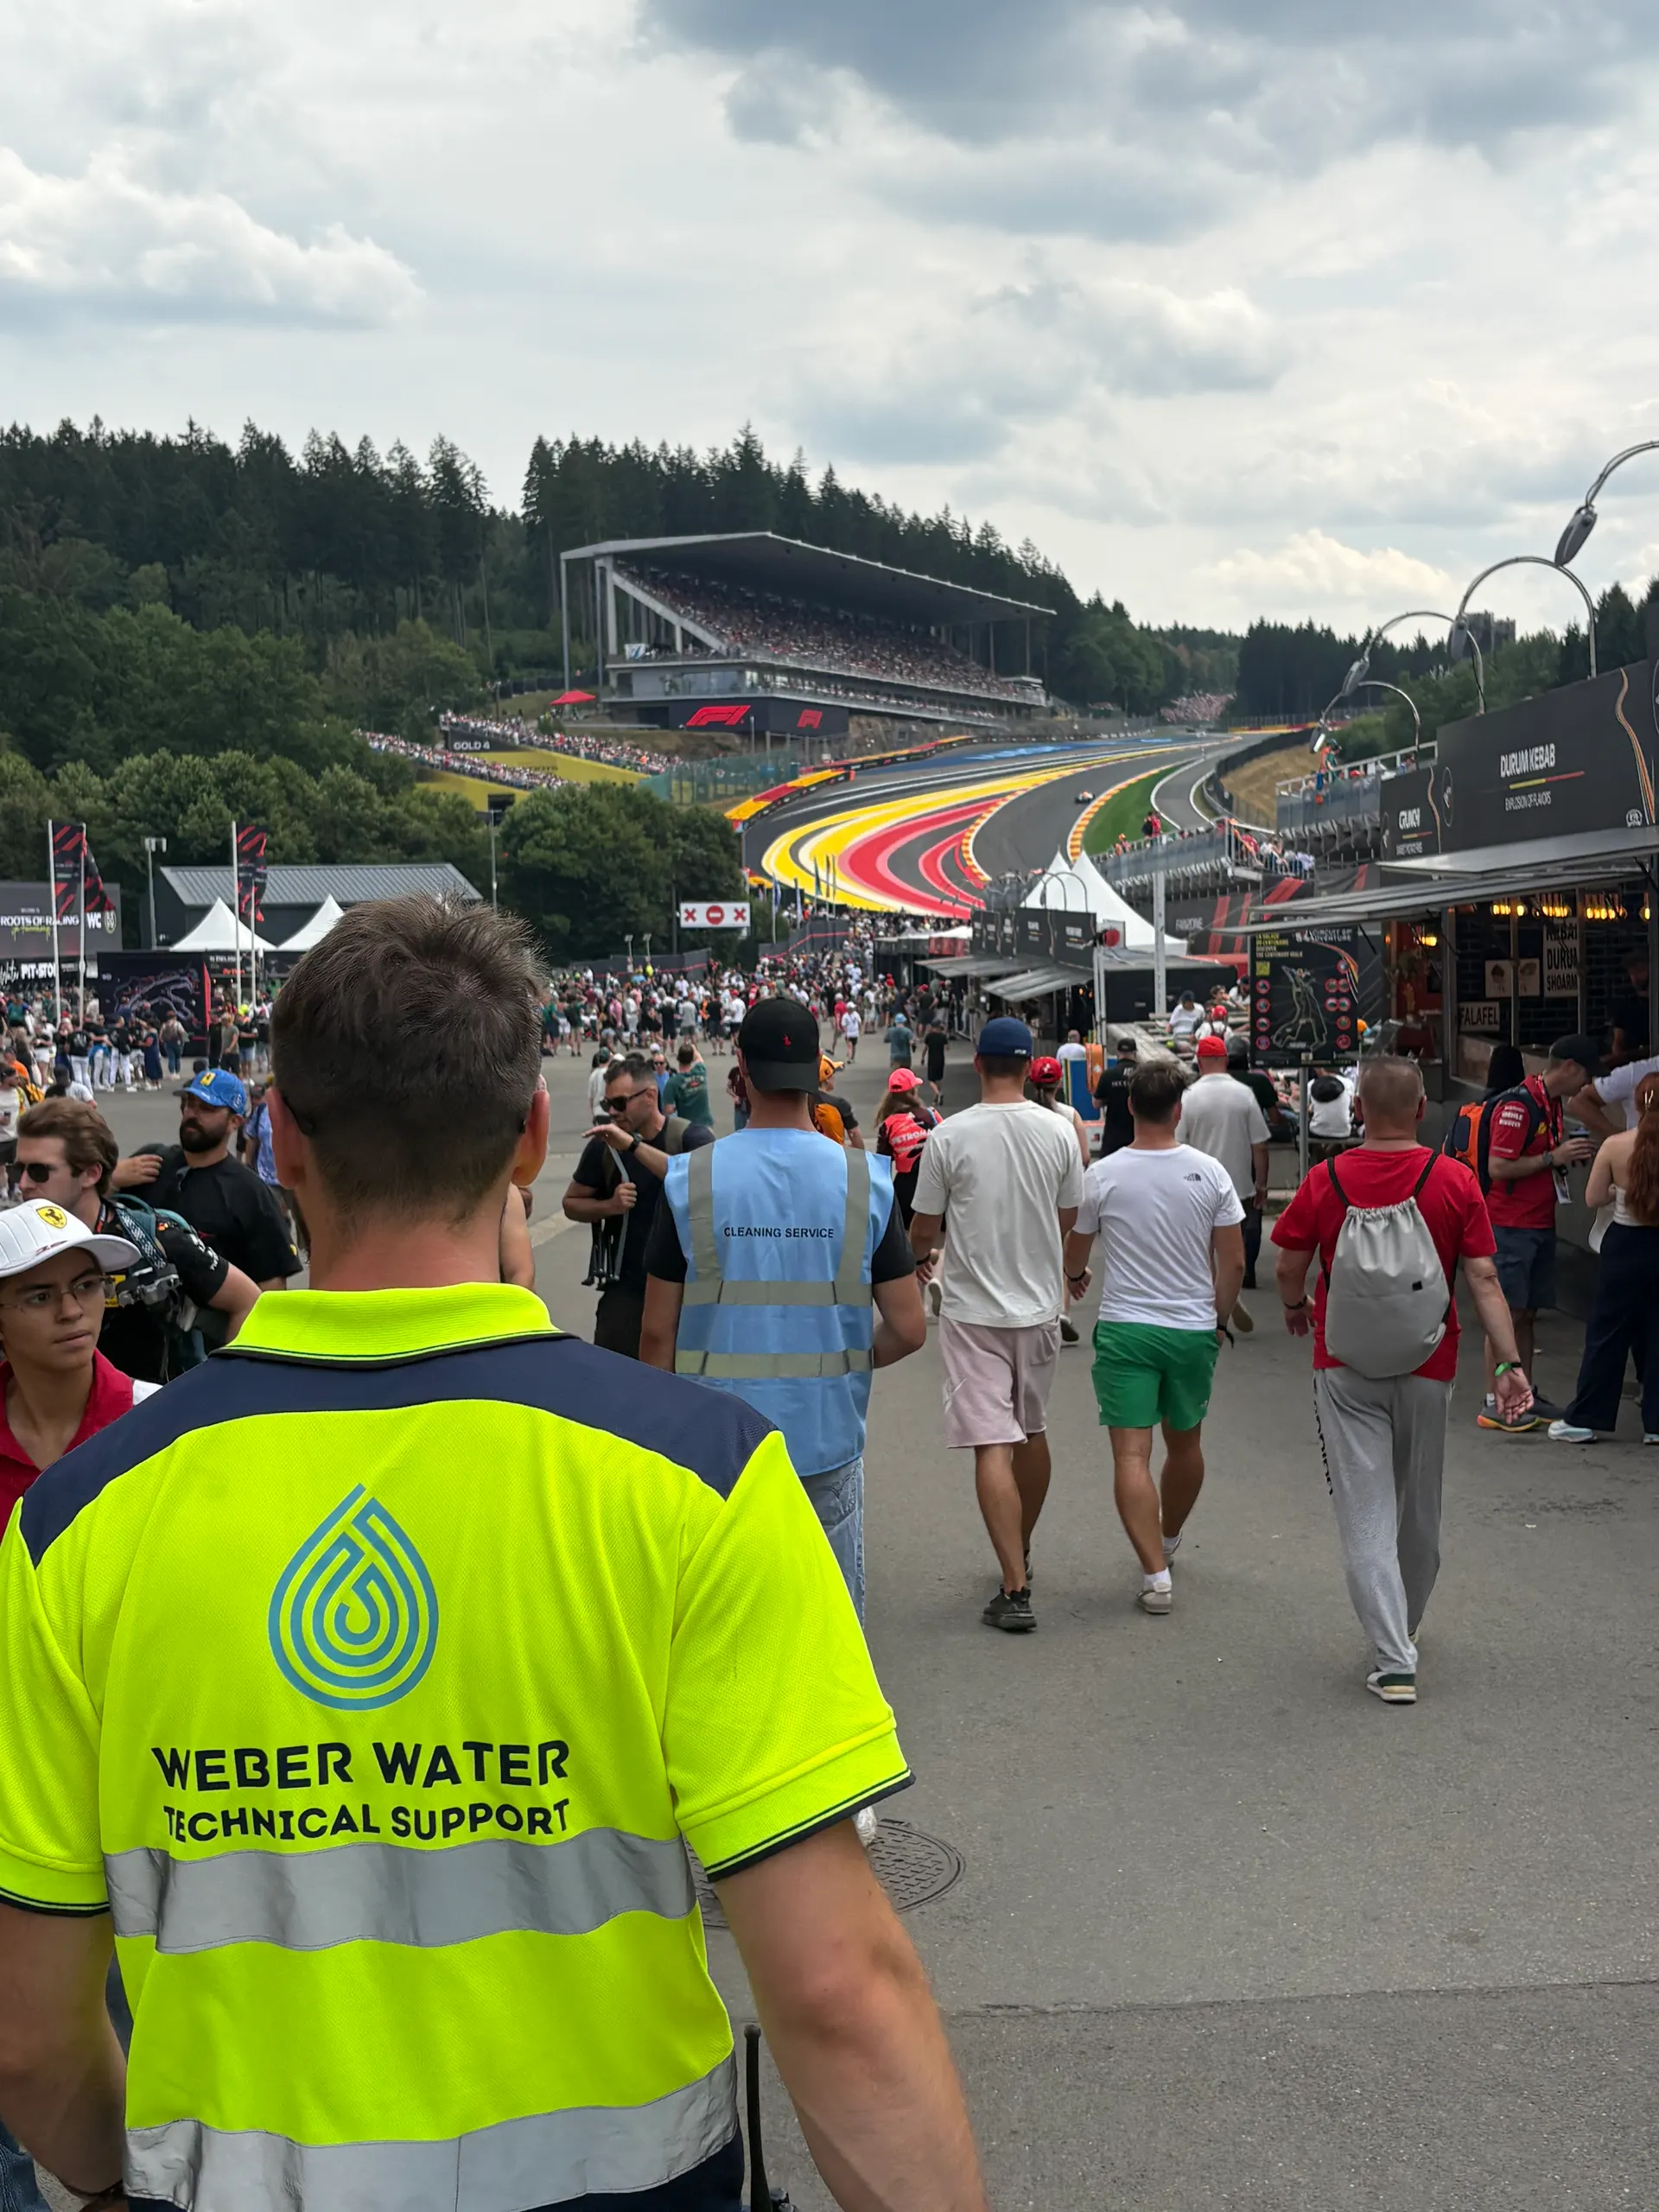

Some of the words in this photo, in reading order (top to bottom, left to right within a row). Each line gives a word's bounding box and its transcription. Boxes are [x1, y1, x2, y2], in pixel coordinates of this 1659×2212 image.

[454, 741, 481, 751] GOLD
[483, 741, 490, 750] 4
[1500, 750, 1529, 778] DURUM
[1529, 742, 1555, 772] KEBAB
[0, 916, 32, 926] ROOTS
[46, 916, 79, 926] RING
[86, 912, 102, 929] WC
[1459, 1006, 1498, 1026] FALAFEL
[724, 1227, 781, 1237] CLEANING
[785, 1228, 835, 1238] SERVICE
[151, 1742, 353, 1792] WEBER
[372, 1739, 570, 1789] WATER
[162, 1803, 381, 1843] TECHNICAL
[390, 1798, 570, 1841] SUPPORT
